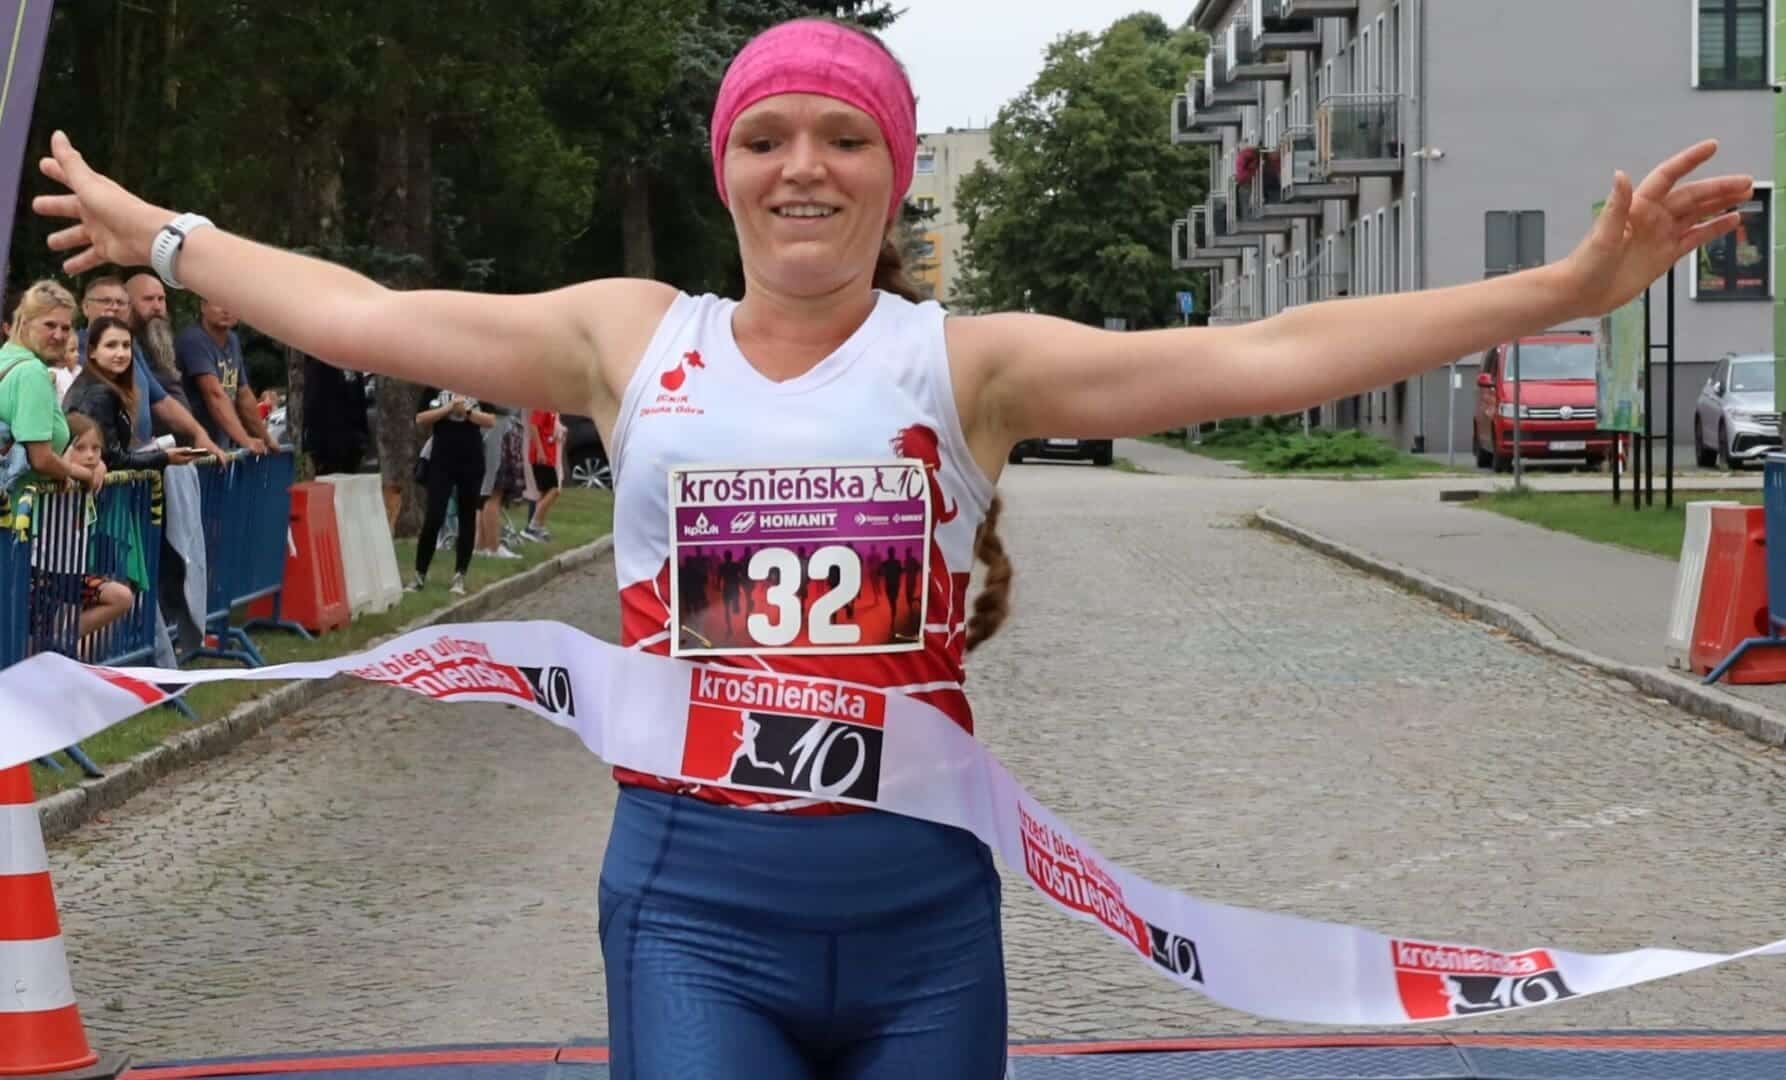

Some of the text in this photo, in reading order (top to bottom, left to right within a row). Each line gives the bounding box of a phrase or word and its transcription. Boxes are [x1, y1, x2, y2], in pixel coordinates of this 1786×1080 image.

[681, 467, 864, 503] krośnieńska
[760, 513, 837, 528] HOMANIT
[748, 545, 861, 646] 32
[699, 670, 866, 720] krośnieńska
[789, 720, 866, 797] 10
